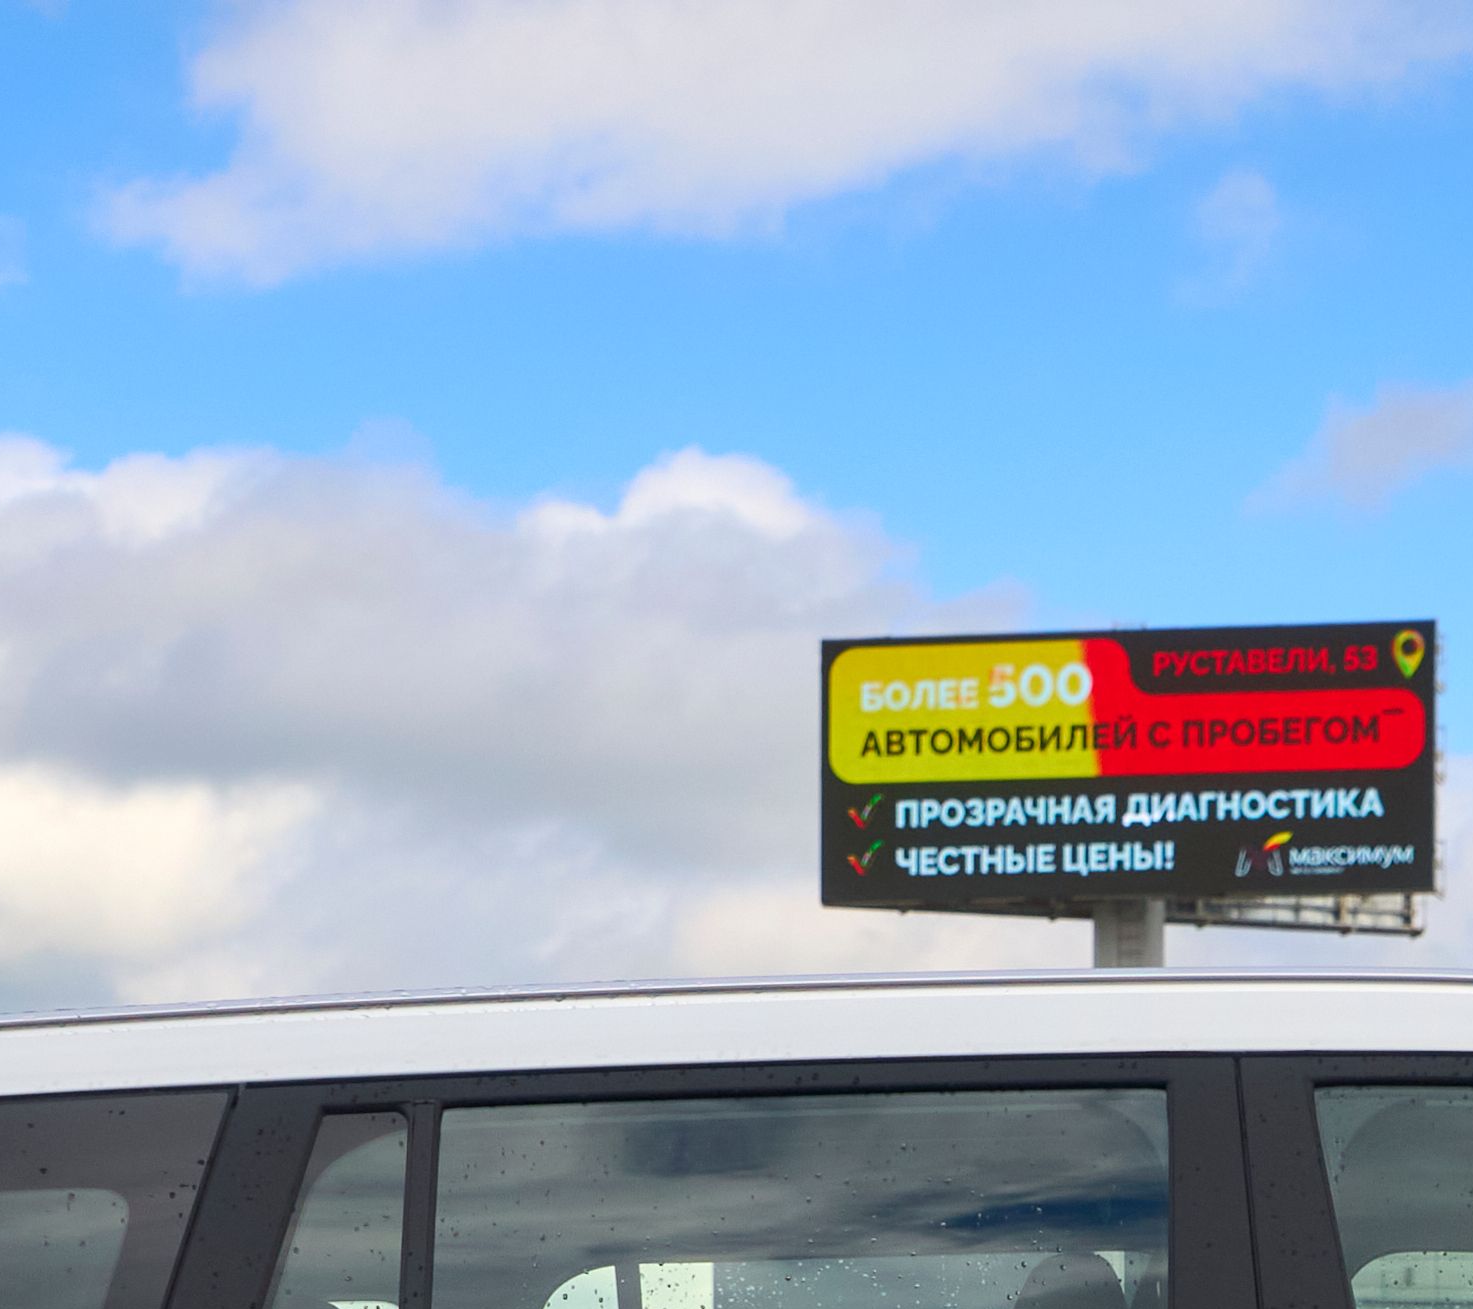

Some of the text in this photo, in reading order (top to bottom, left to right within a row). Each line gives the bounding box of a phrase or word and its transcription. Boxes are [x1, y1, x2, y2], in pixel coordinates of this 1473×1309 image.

[1153, 645, 1378, 677] РУСТАВЕЛИ, 53
[860, 662, 1094, 712] БОЛЕЕ 500
[861, 714, 1380, 757] АВТОМОБИЛЕЙ С ПРОБЕГОМ
[895, 786, 1384, 829] ПРОЗРАЧНАЯ ДИАГНОСТИКА
[895, 840, 1175, 877] ЧЕСТНЫЕ ЦЕНЫ!
